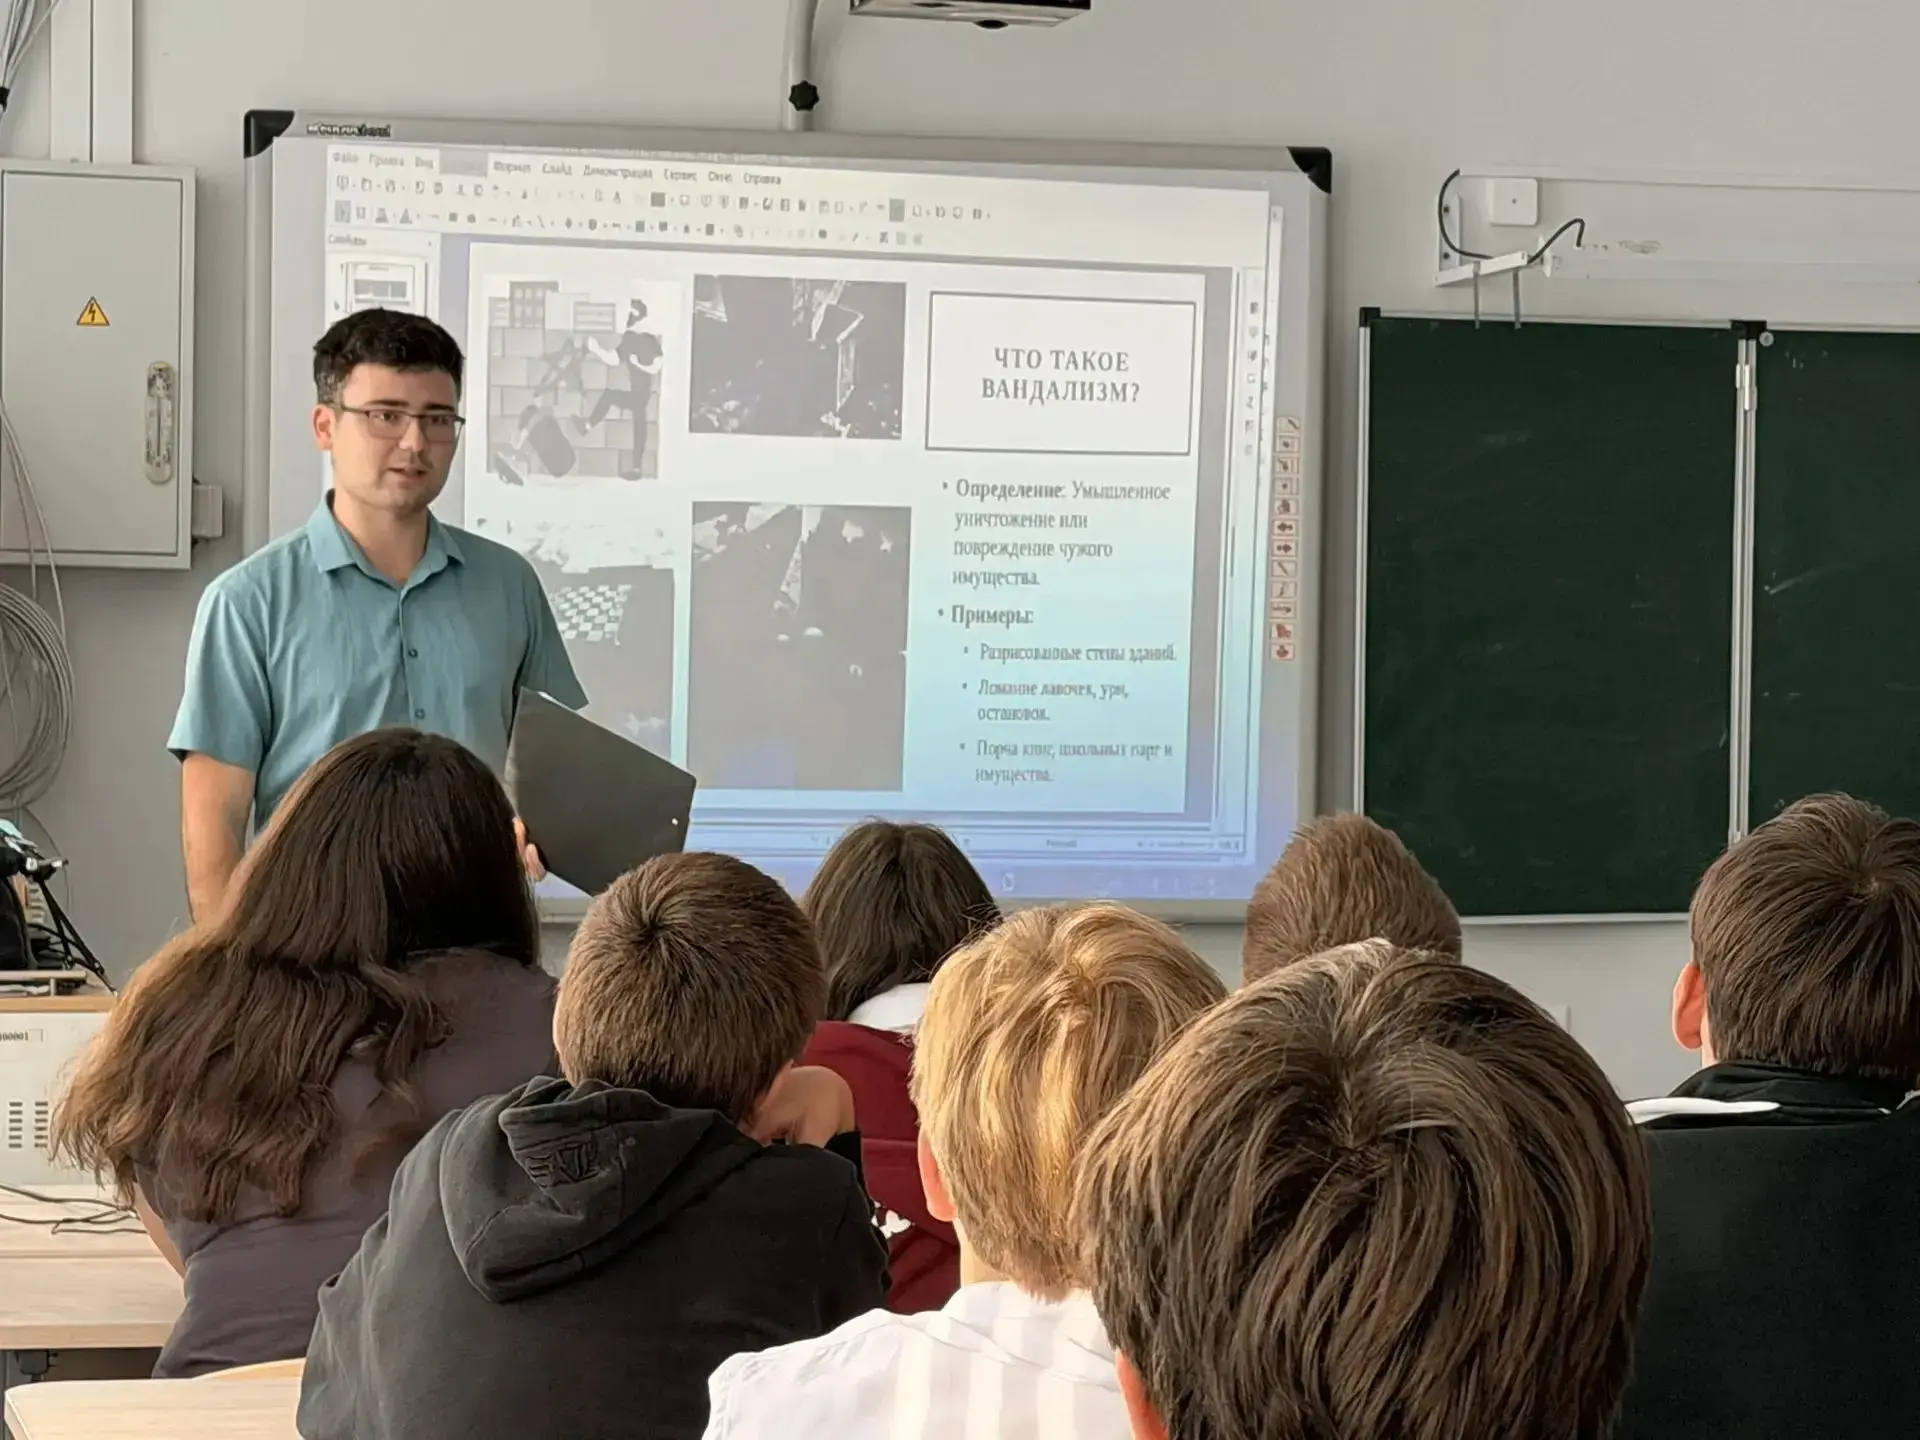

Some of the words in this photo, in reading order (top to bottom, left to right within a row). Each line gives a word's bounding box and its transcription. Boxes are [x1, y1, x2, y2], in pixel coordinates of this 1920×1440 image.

[994, 347, 1043, 369] ЧТО
[1050, 349, 1130, 373] ТАКОЕ
[981, 377, 1141, 406] ВАНДАЛИЗМ?
[955, 479, 1066, 502] Определение:
[1072, 480, 1172, 500] Умышленное
[954, 511, 1056, 531] уничтожение
[1059, 513, 1089, 529] или
[953, 539, 1055, 561] повреждение
[1059, 542, 1114, 562] чужого
[952, 569, 1041, 589] имущества.
[951, 604, 1035, 629] Примеры:
[980, 643, 1081, 665] Разрисованные
[1085, 647, 1126, 661] стены
[977, 678, 1038, 696] Ломание
[977, 706, 1051, 722] остановок.
[976, 740, 1018, 761] Порча
[1163, 745, 1174, 757] и
